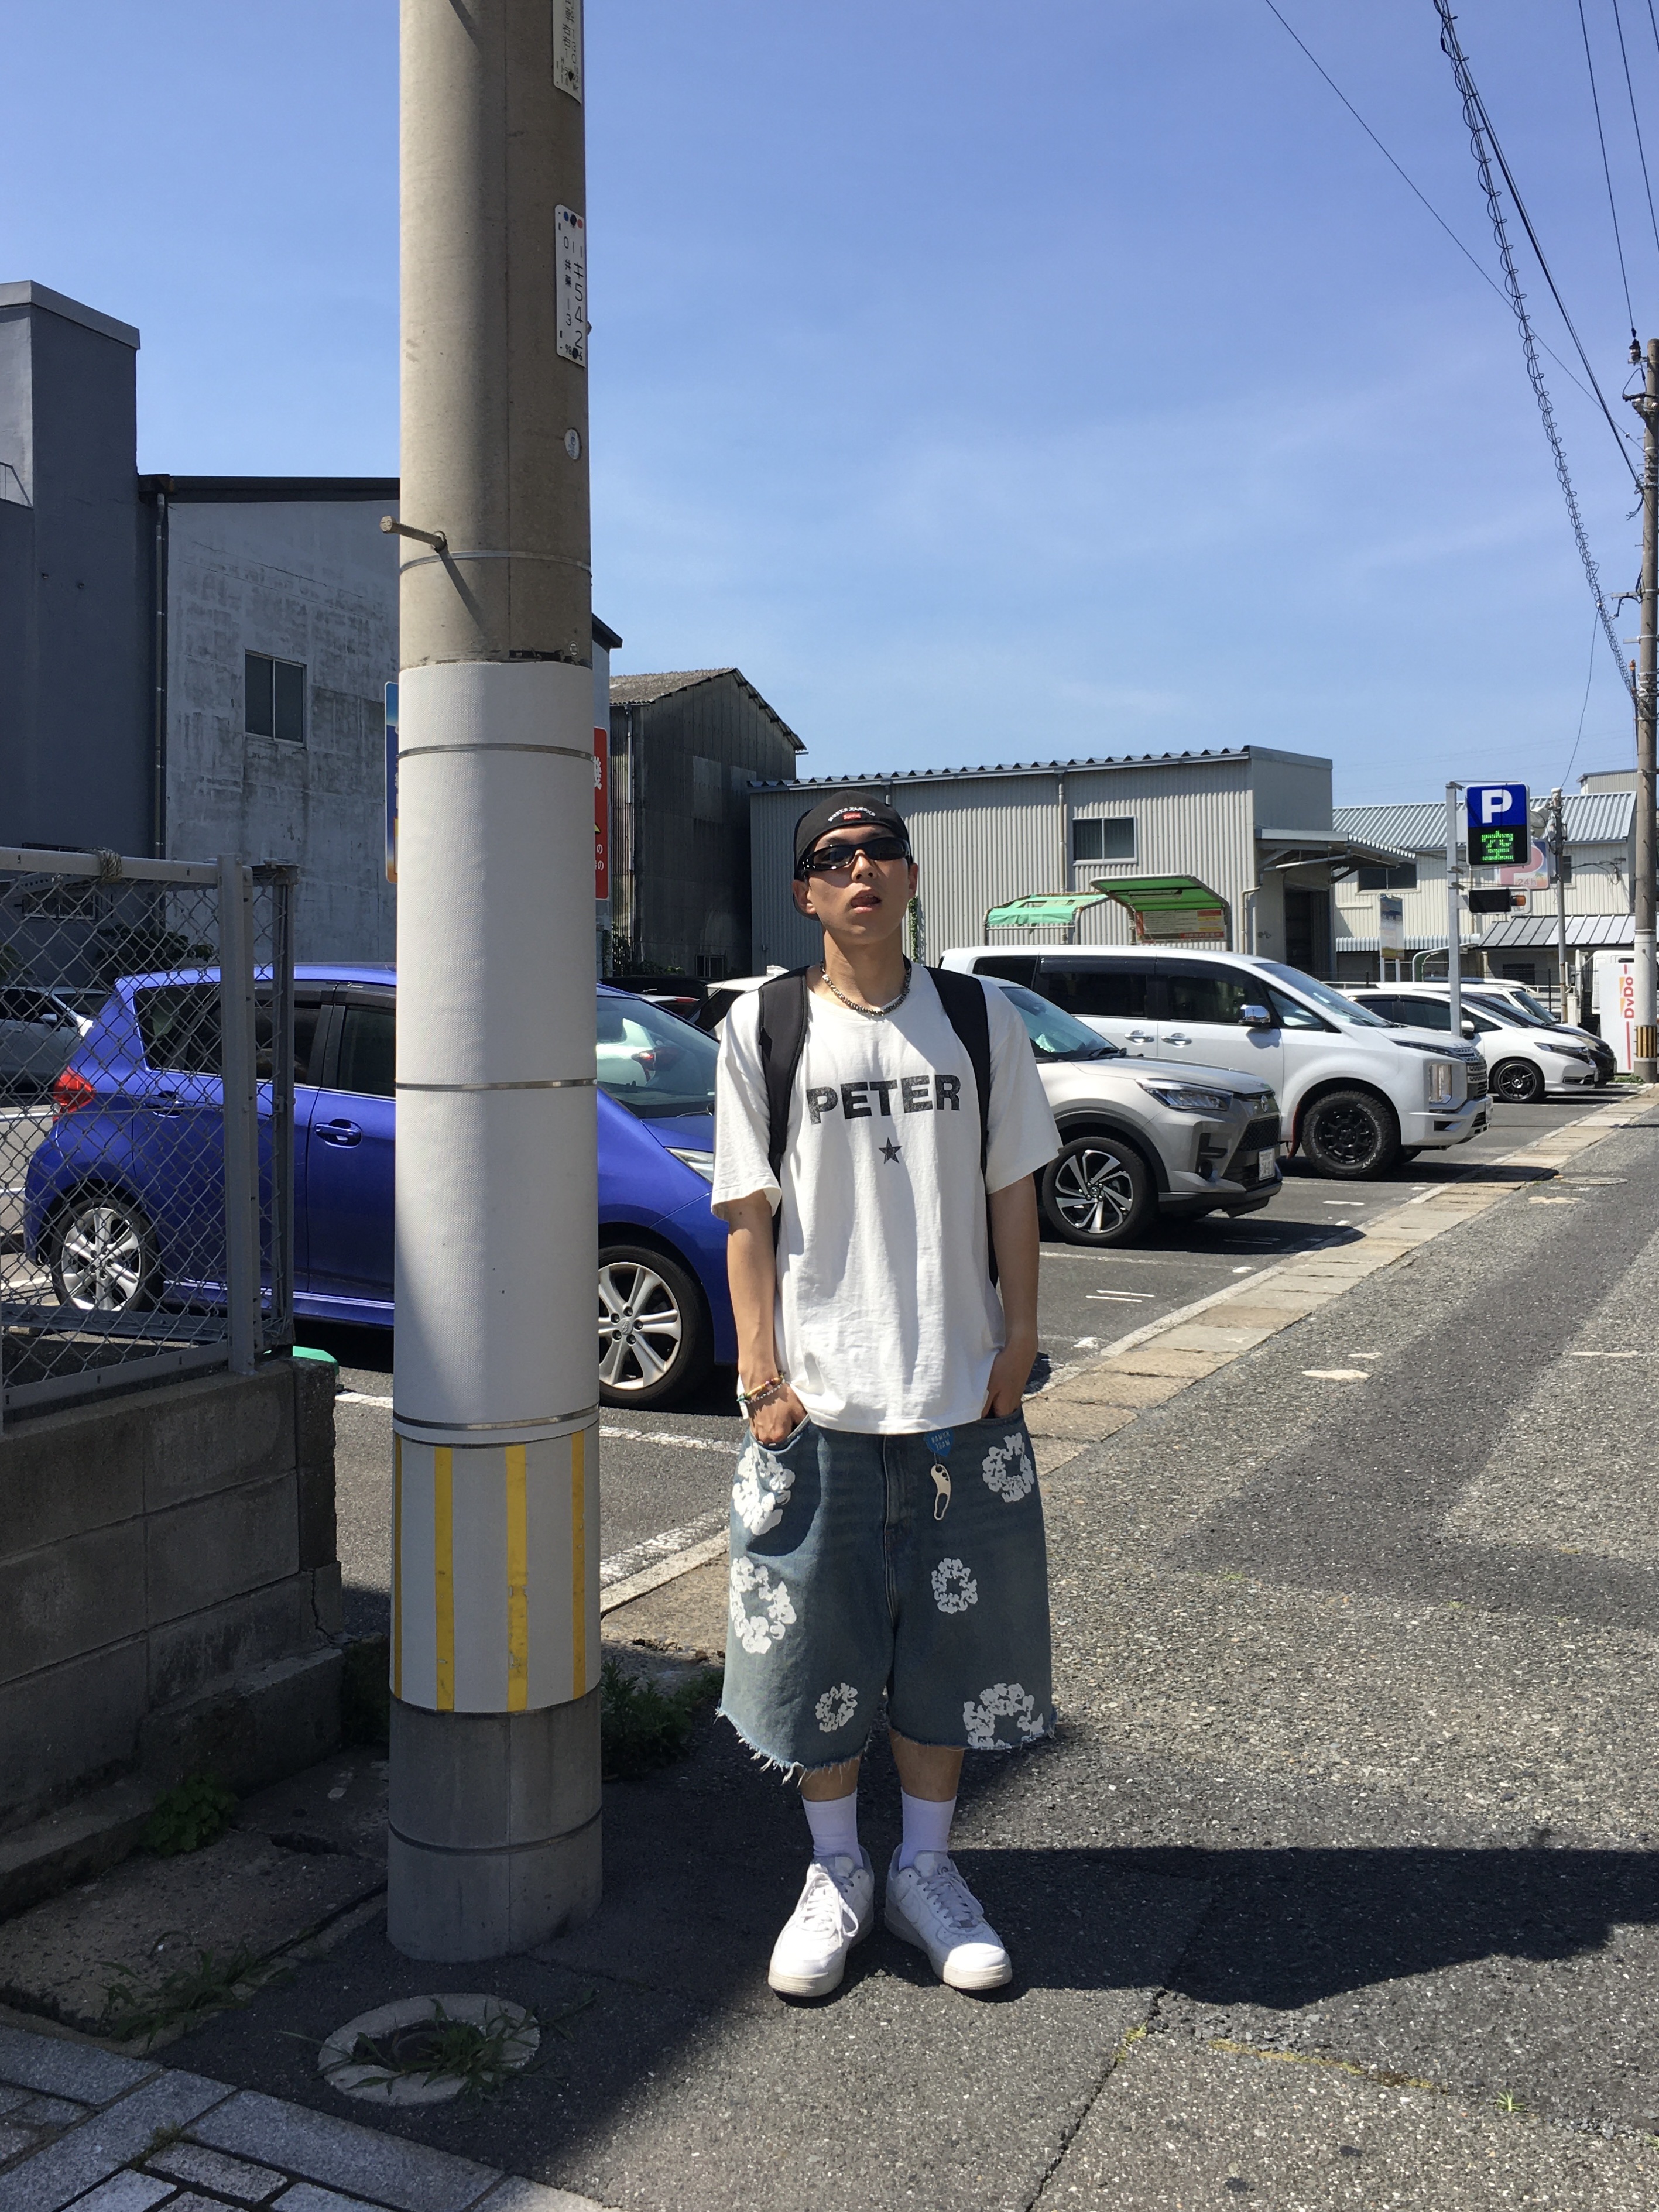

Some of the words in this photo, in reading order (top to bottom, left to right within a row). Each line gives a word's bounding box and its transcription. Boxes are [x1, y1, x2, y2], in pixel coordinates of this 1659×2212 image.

[1481, 789, 1513, 824] P
[1482, 830, 1514, 861] 空
[1517, 878, 1537, 886] 24h
[807, 1074, 961, 1125] PETER
